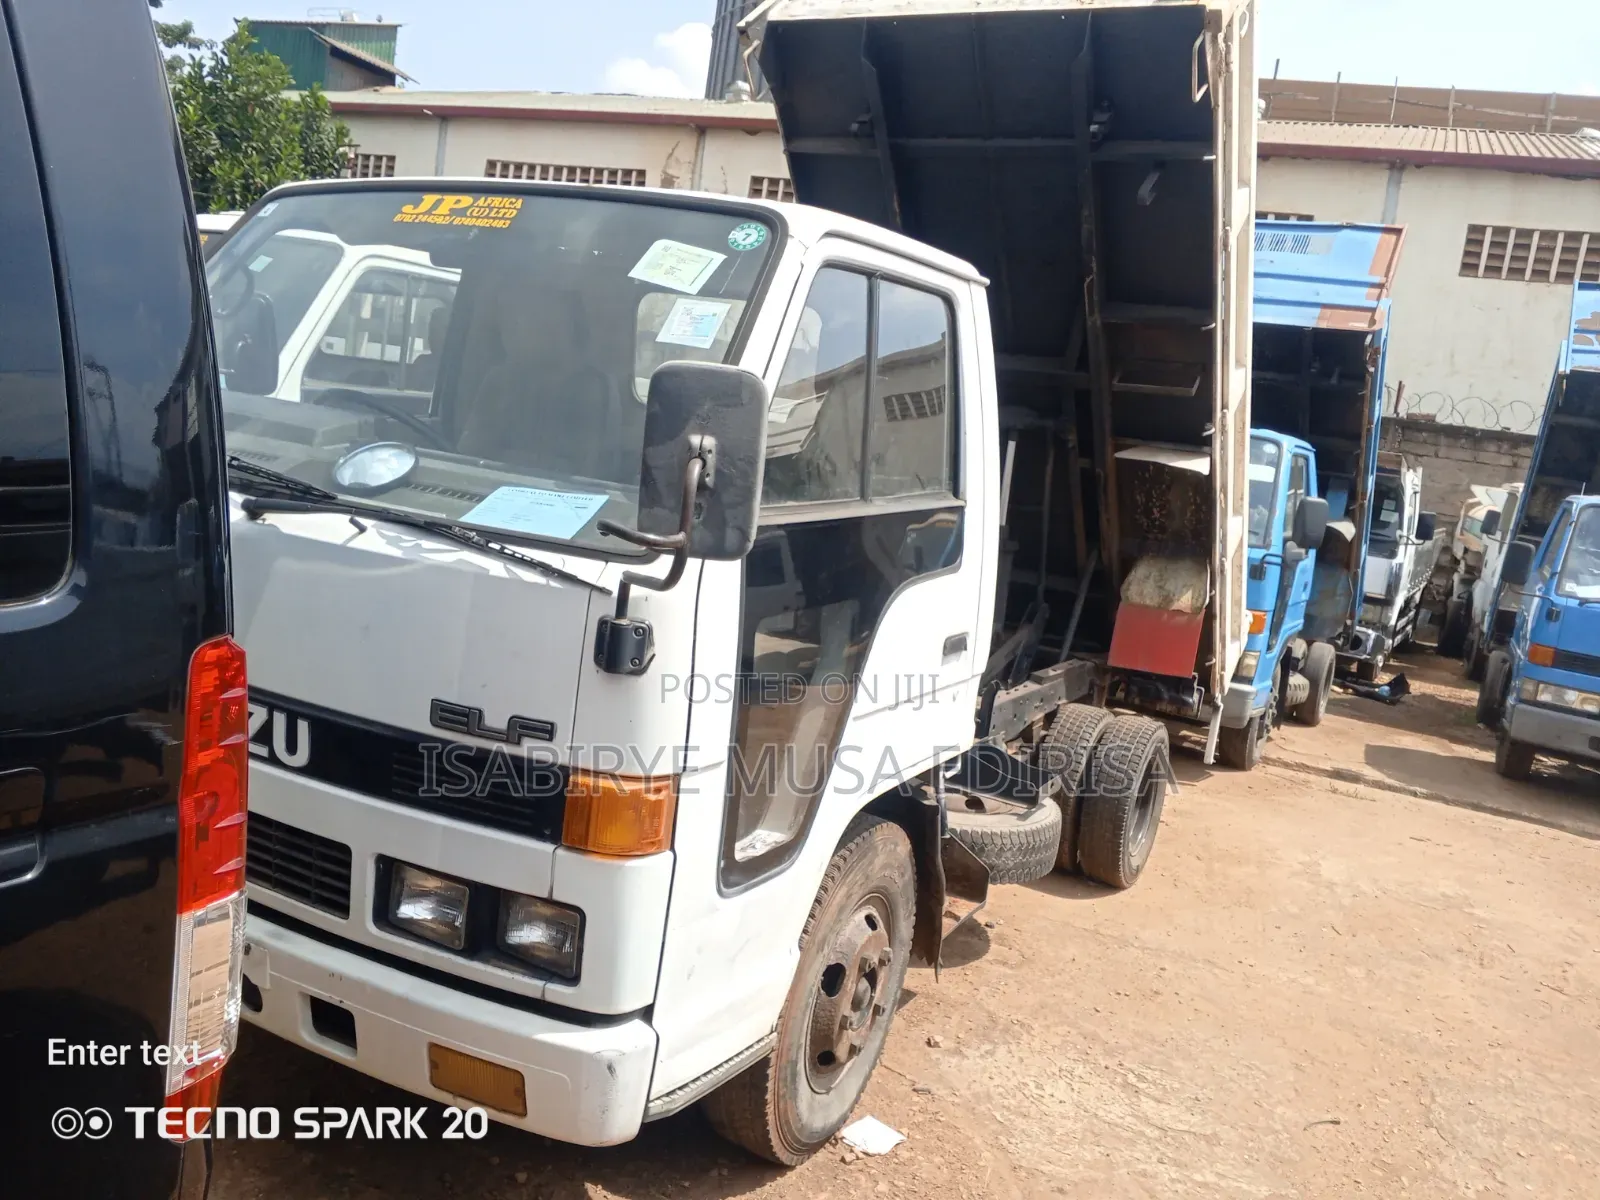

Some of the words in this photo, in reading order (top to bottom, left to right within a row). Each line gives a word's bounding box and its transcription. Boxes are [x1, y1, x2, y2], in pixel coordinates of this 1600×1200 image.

[401, 194, 474, 214] JP
[474, 197, 523, 209] AFRICA
[466, 207, 489, 218] (U)
[489, 208, 518, 218] LTD
[248, 703, 312, 768] ZU
[430, 698, 557, 744] ELF
